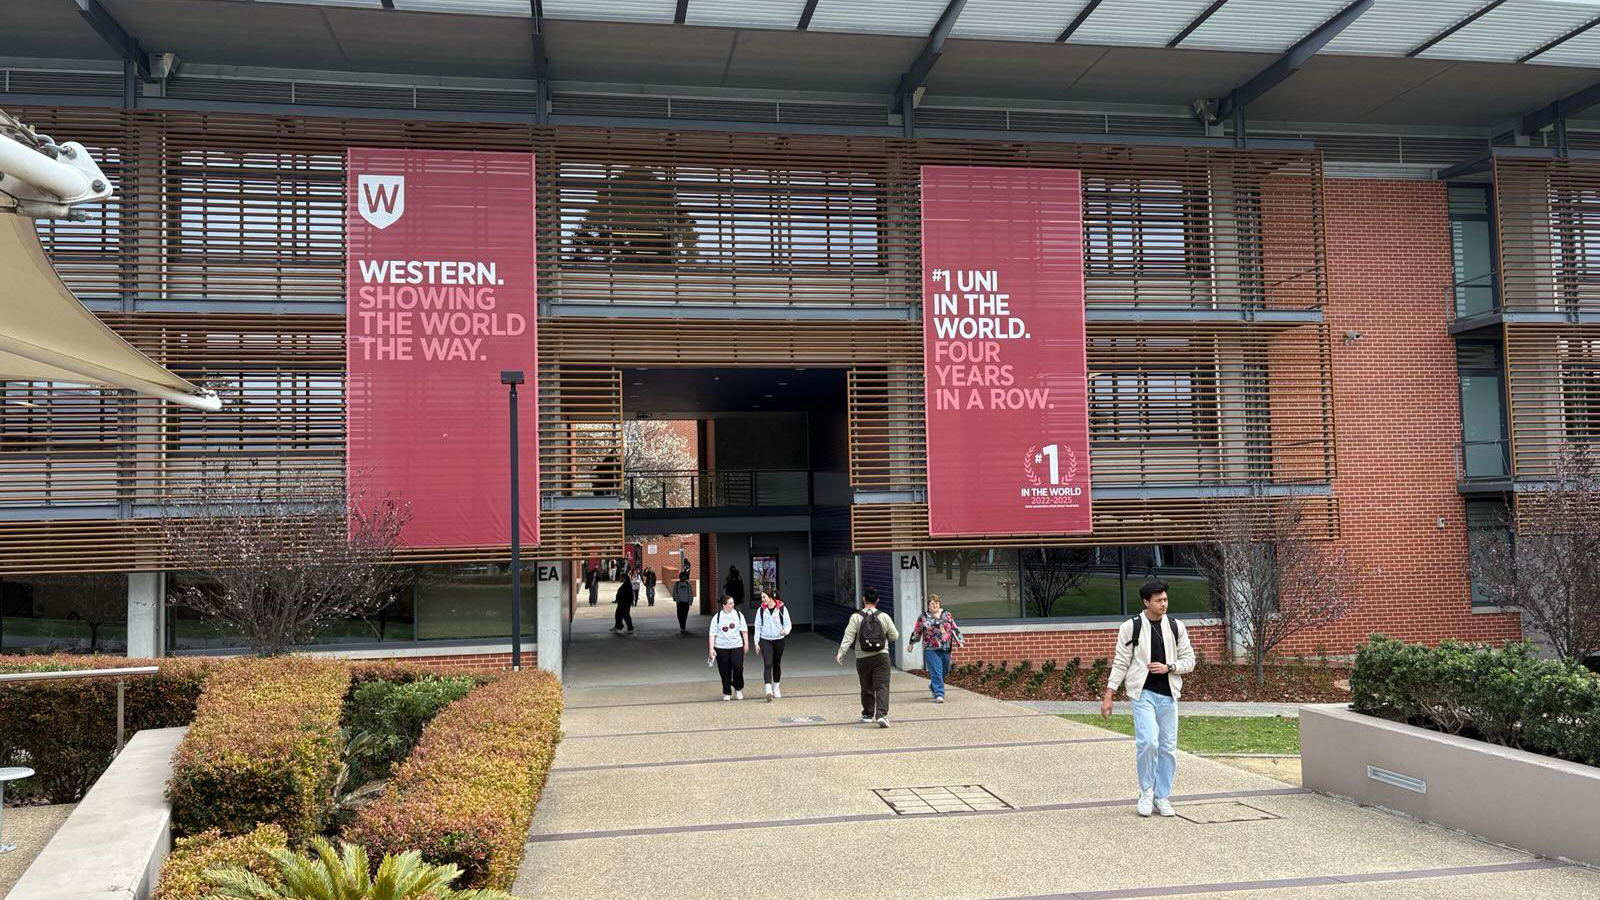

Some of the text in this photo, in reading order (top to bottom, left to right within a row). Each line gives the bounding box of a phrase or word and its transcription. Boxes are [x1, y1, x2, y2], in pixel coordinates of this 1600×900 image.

[364, 183, 399, 214] W
[359, 260, 504, 285] WESTERN.
[932, 268, 997, 291] #1 UNI
[359, 286, 496, 310] SHOWING
[934, 294, 1009, 315] IN THE
[359, 311, 526, 336] THE WORLD
[934, 317, 1030, 338] WORLD.
[359, 337, 487, 361] THE WAY.
[935, 341, 1000, 363] FOUR
[935, 364, 1014, 386] YEARS
[936, 388, 1054, 410] IN A ROW.
[1035, 444, 1059, 484] #1
[1021, 487, 1081, 496] IN THE WORLD
[1031, 496, 1072, 504] 2022-2025
[539, 566, 559, 581] EA
[901, 555, 919, 570] EA
